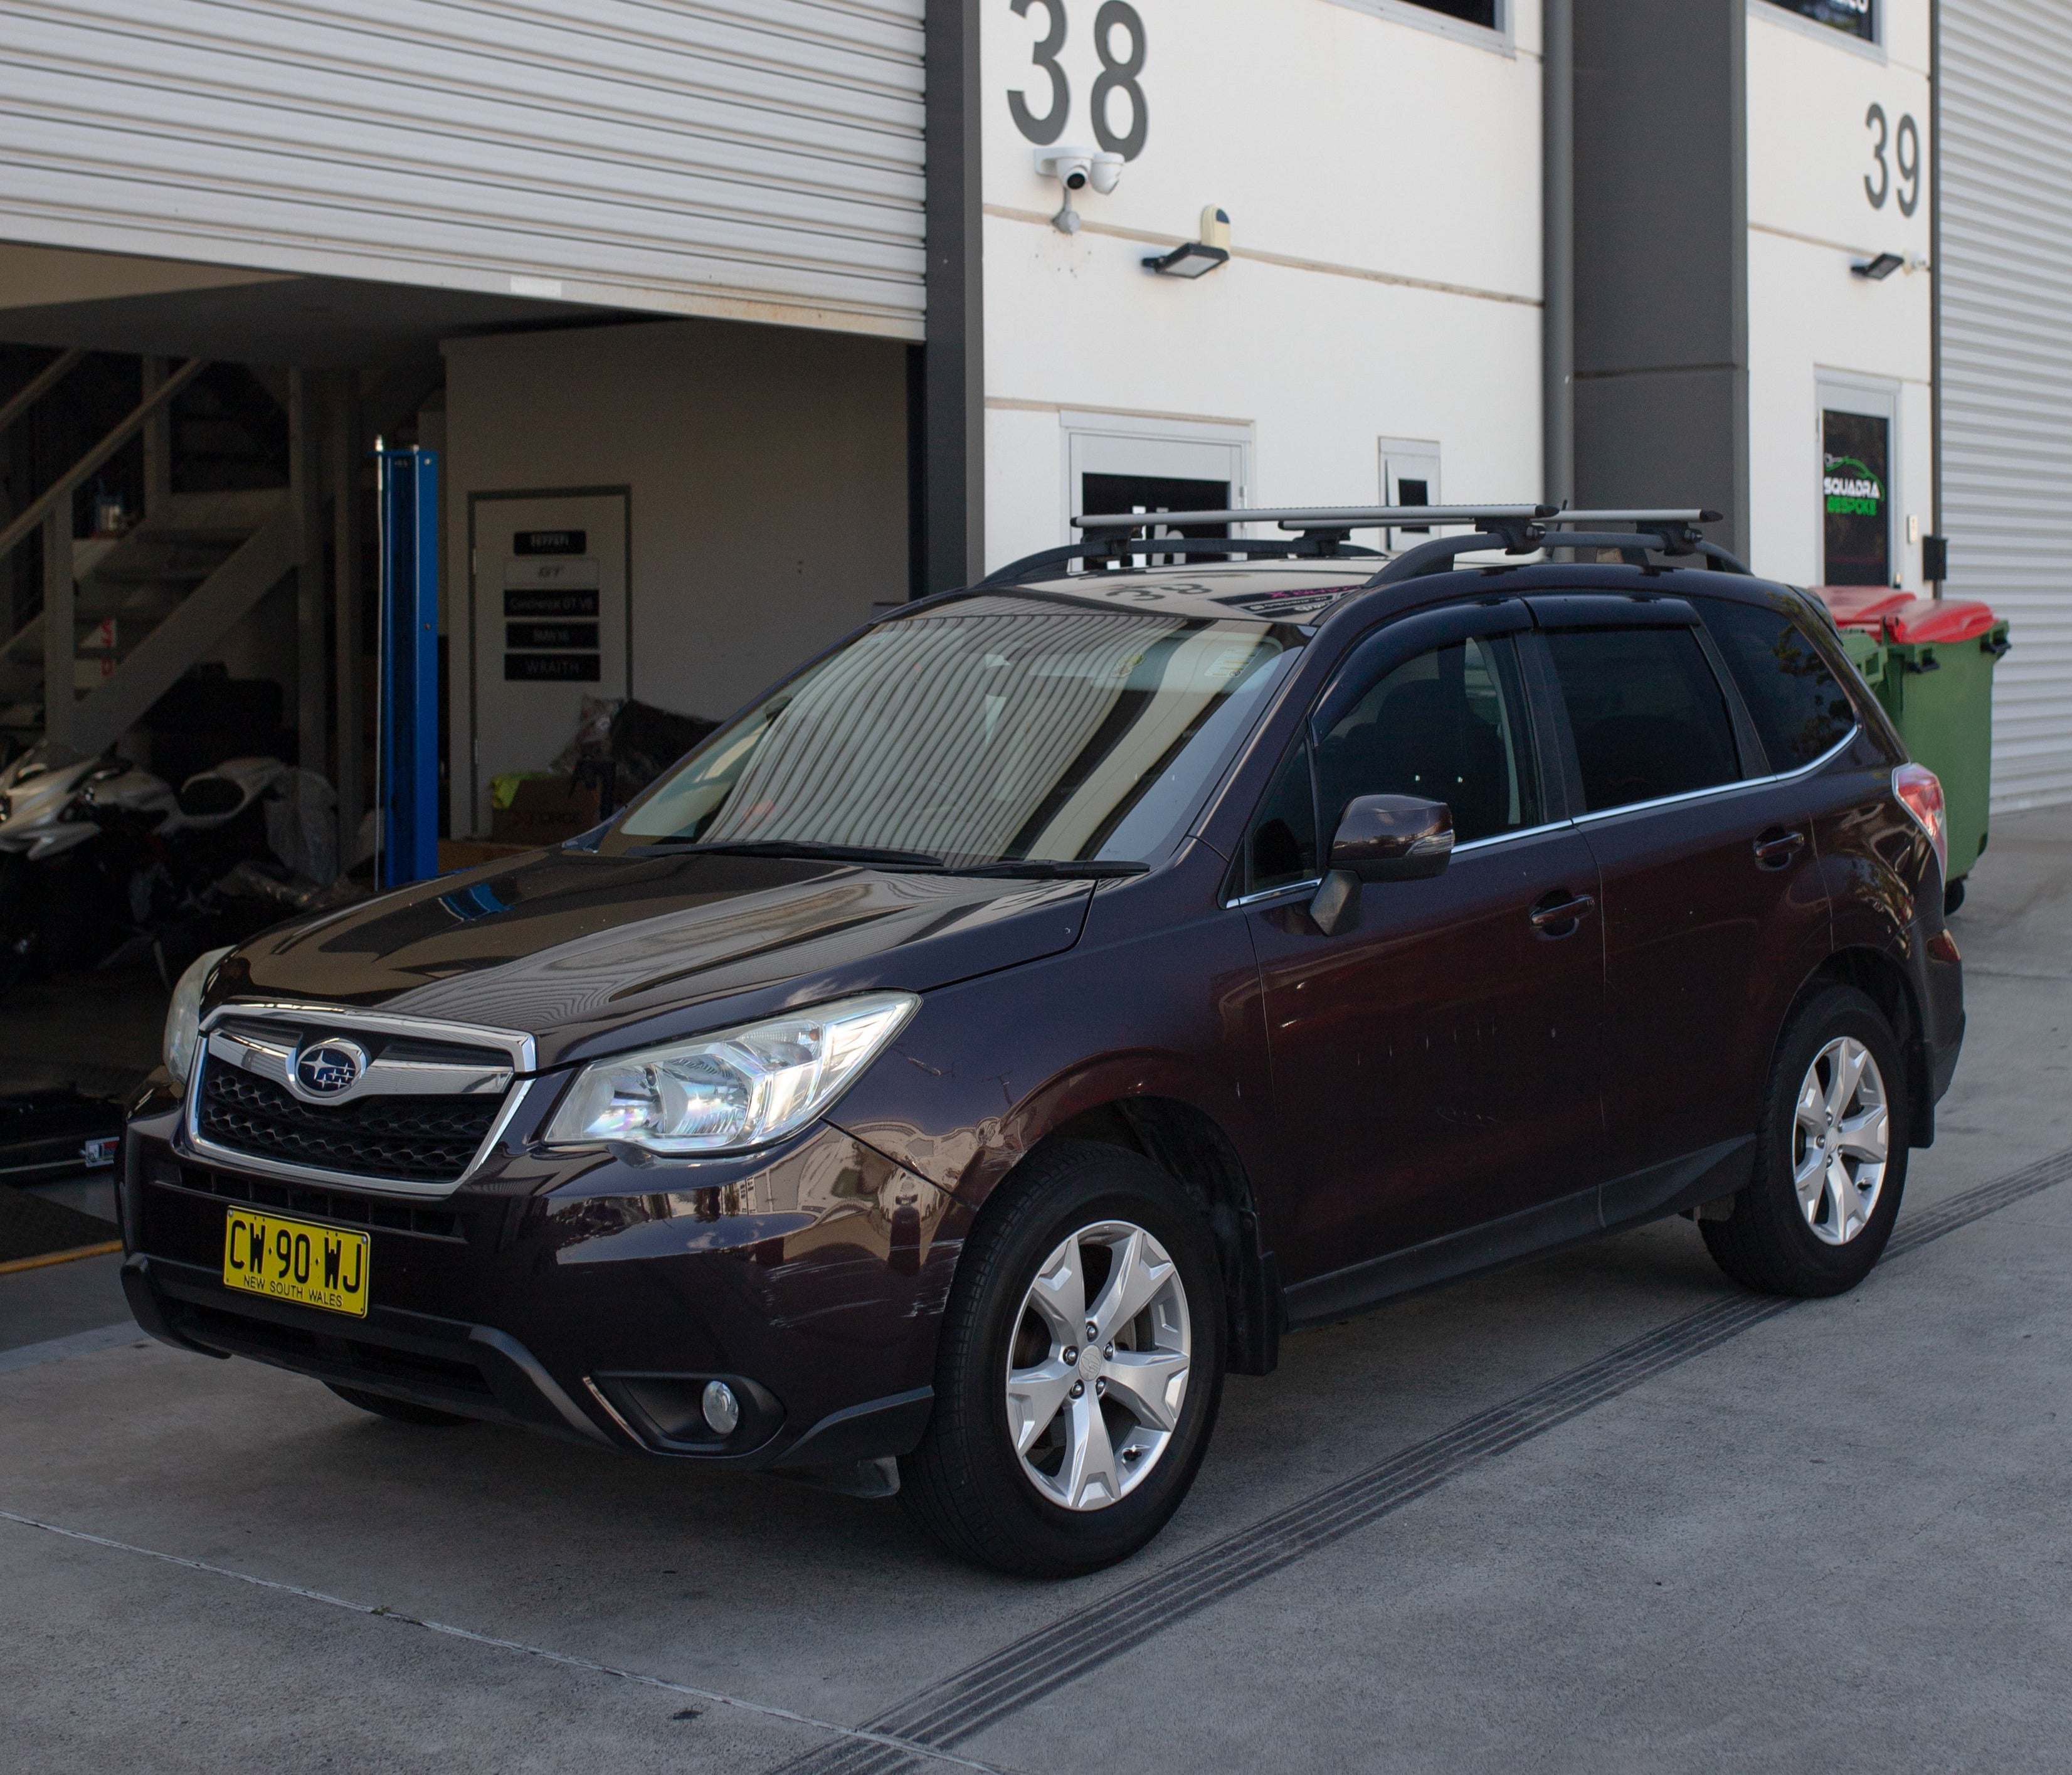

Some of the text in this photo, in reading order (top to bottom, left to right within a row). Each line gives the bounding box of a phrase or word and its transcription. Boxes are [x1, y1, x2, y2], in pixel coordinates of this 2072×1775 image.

[1007, 0, 1149, 162] 38
[1864, 101, 1920, 219] 39
[1823, 477, 1881, 499] SQUADRA
[243, 1274, 344, 1307] NEW SOUTH WALES
